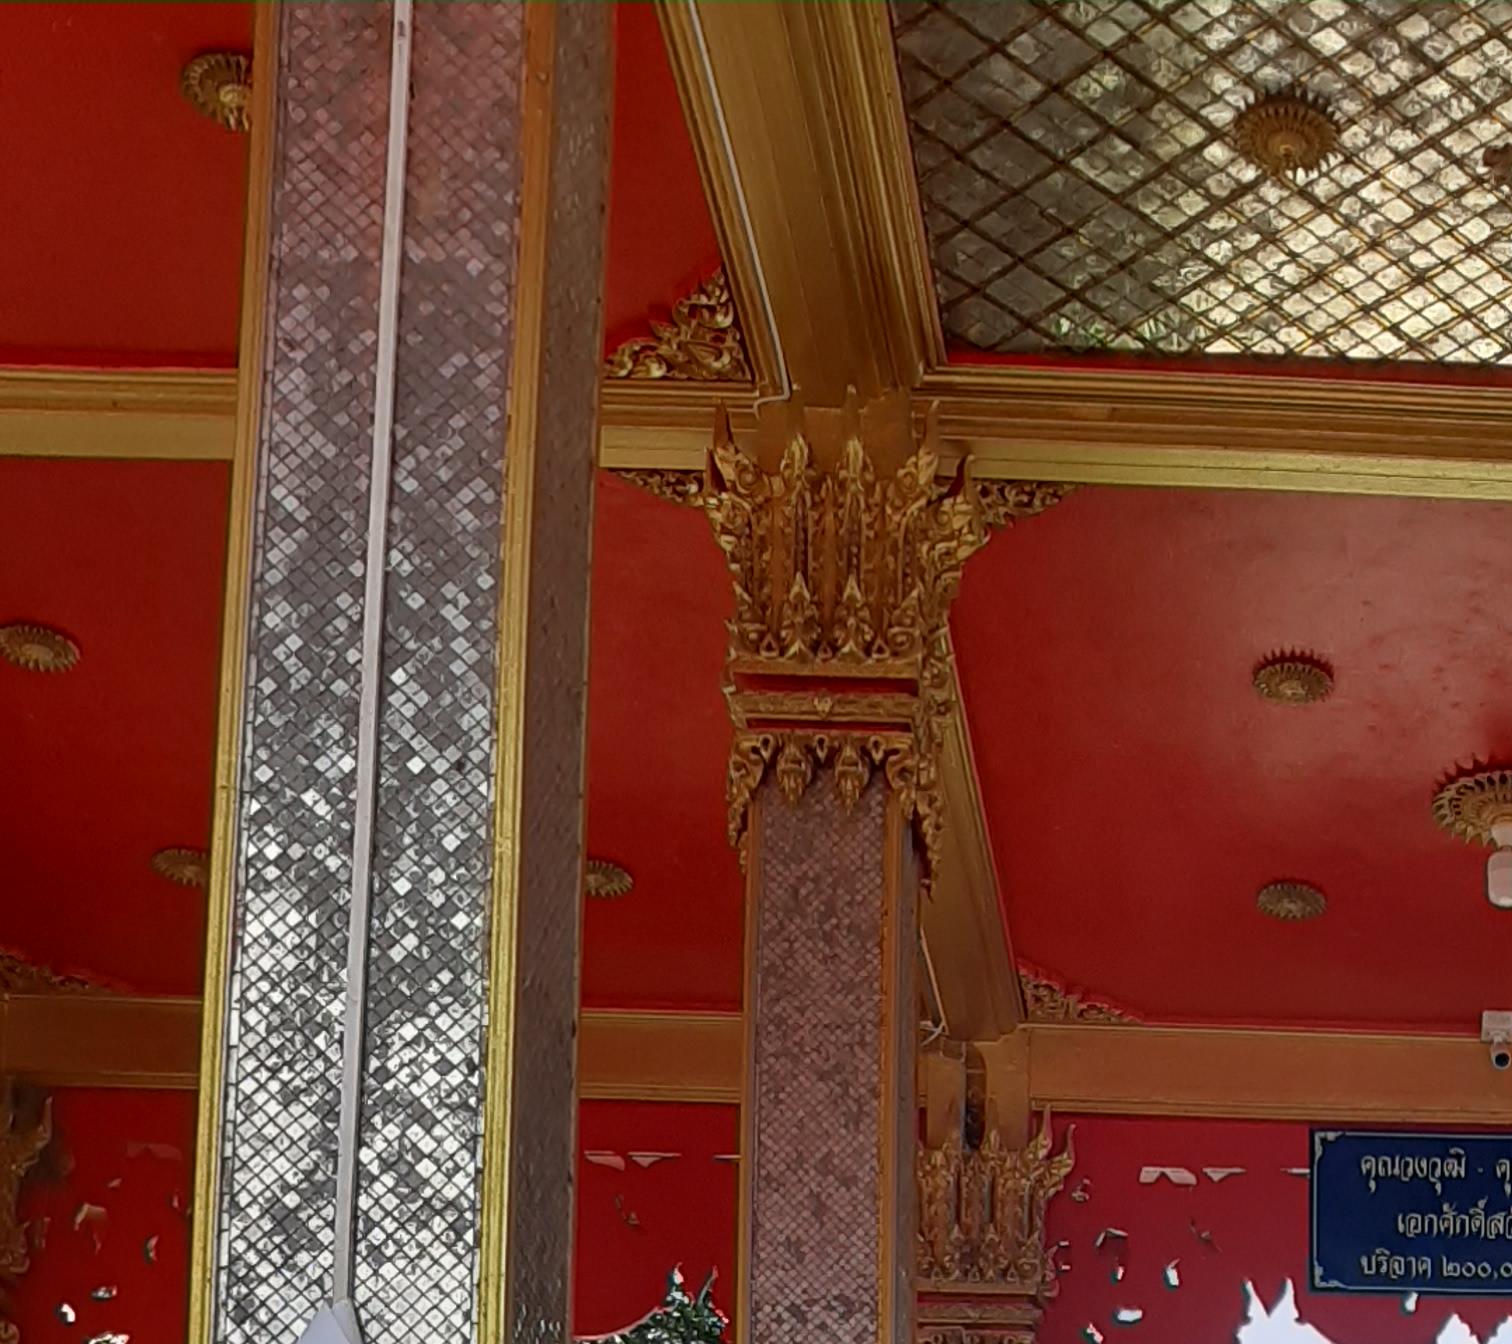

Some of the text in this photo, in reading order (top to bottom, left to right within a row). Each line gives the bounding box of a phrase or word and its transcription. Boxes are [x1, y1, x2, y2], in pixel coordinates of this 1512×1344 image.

[1361, 1147, 1466, 1195] คุณวงวุฒิ
[1360, 1247, 1432, 1280] บริจาค
